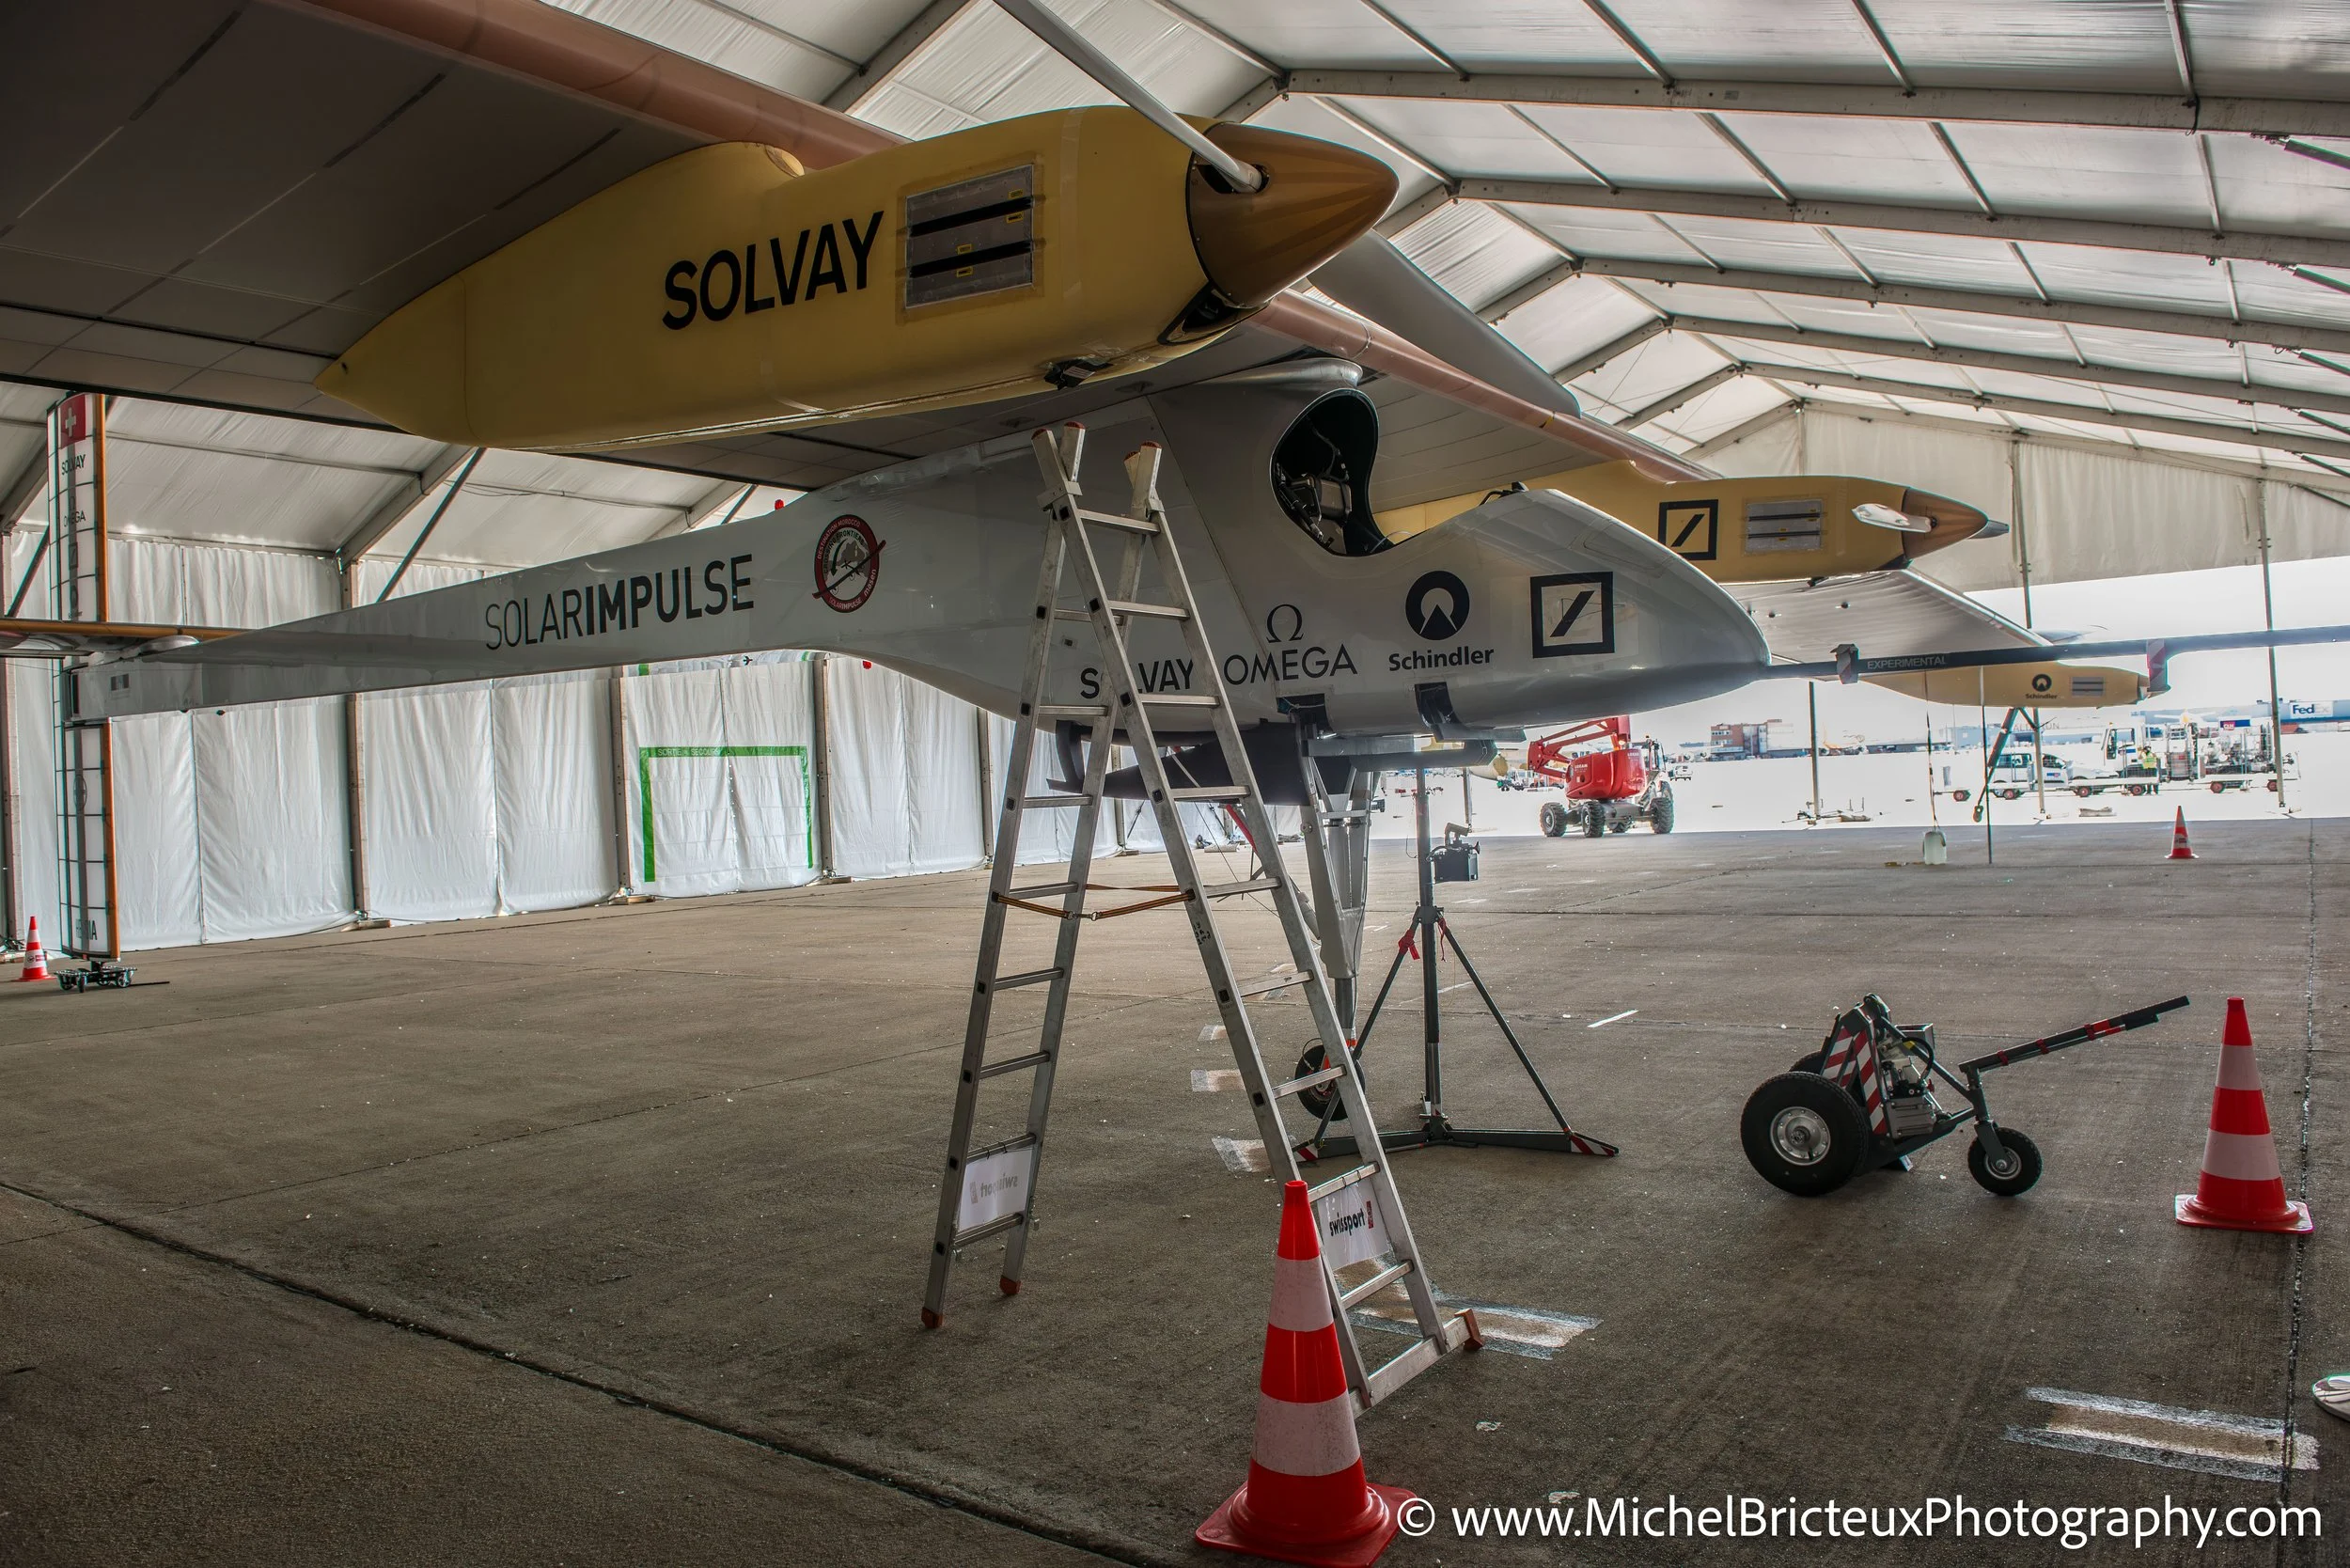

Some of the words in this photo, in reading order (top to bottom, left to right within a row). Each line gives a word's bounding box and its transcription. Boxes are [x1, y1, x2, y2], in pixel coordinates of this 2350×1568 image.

[662, 211, 885, 331] SOLVAY
[61, 454, 86, 476] SOLVAY
[485, 554, 755, 651] SOLARIMPULSE
[1223, 644, 1358, 685] OMEGA
[1388, 646, 1495, 671] Schindler
[1867, 655, 1947, 669] EXPERIMENTAL
[1080, 658, 1194, 699] SVAY
[1329, 1208, 1366, 1237] swissport
